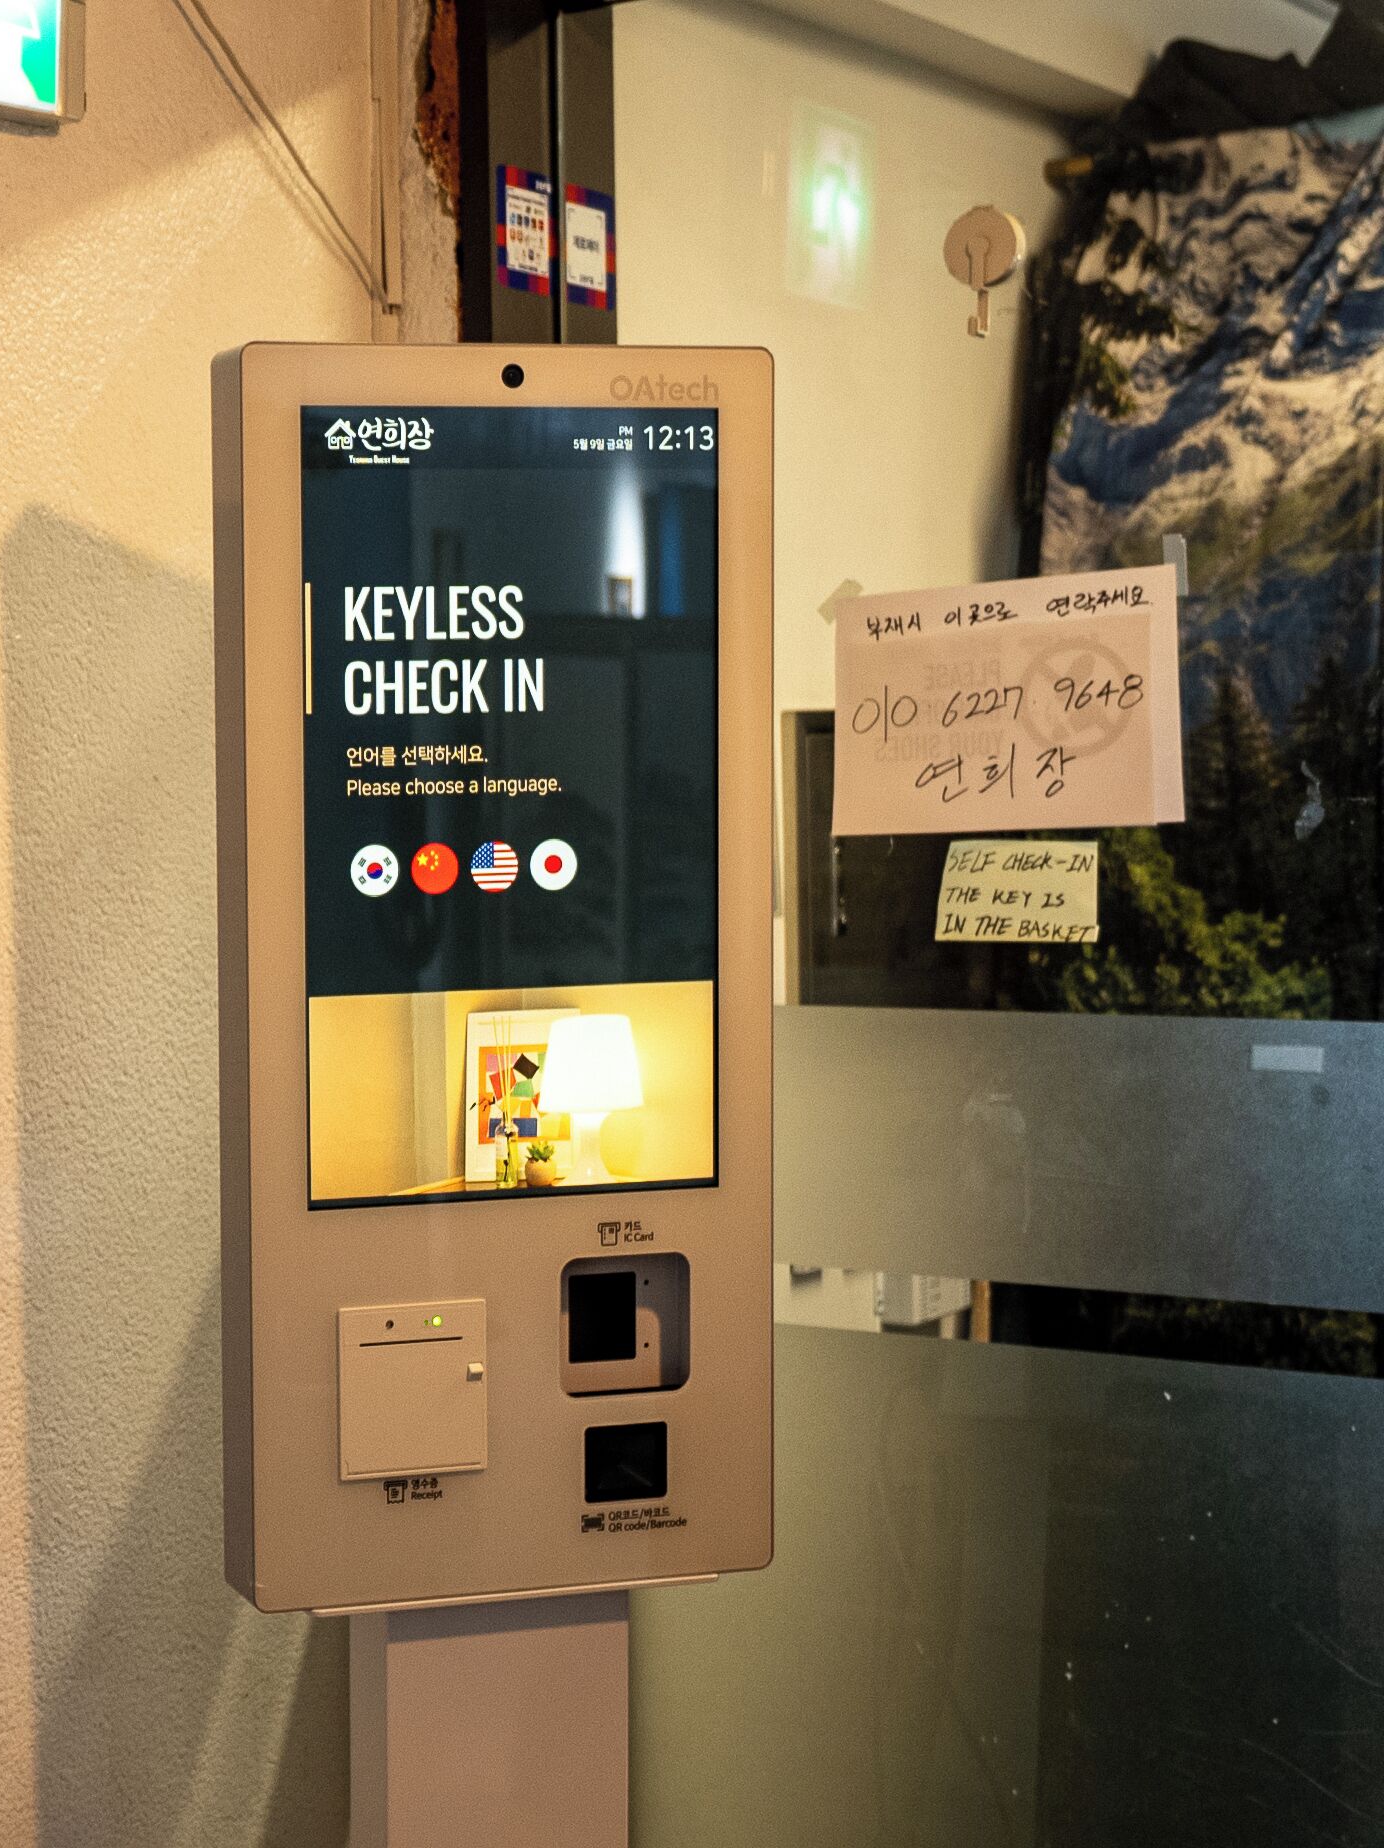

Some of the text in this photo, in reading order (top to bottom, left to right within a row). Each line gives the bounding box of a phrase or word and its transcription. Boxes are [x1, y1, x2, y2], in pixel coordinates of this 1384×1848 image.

[610, 374, 719, 401] OAtech
[358, 417, 434, 451] 연희장
[618, 426, 633, 436] PM
[643, 425, 714, 451] 12:13
[573, 438, 633, 451] 5월 9일 금요일
[344, 585, 525, 642] KEYLESS
[866, 612, 922, 641] 부재시
[344, 658, 544, 715] CHECK IN
[852, 685, 918, 743] 010
[1054, 673, 1144, 712] 9648
[346, 745, 488, 767] 언어를 선택하세요.
[347, 775, 562, 797] Please choose a language.
[948, 850, 1094, 874] SELF CHECK-IN
[945, 887, 1065, 908] THE KEY IS
[942, 914, 1097, 942] IN THE BASKET
[623, 1231, 654, 1242] IC Card
[624, 1221, 642, 1232] 카드
[411, 1488, 443, 1501] Receipt
[608, 1517, 687, 1533] QR code/Barcode
